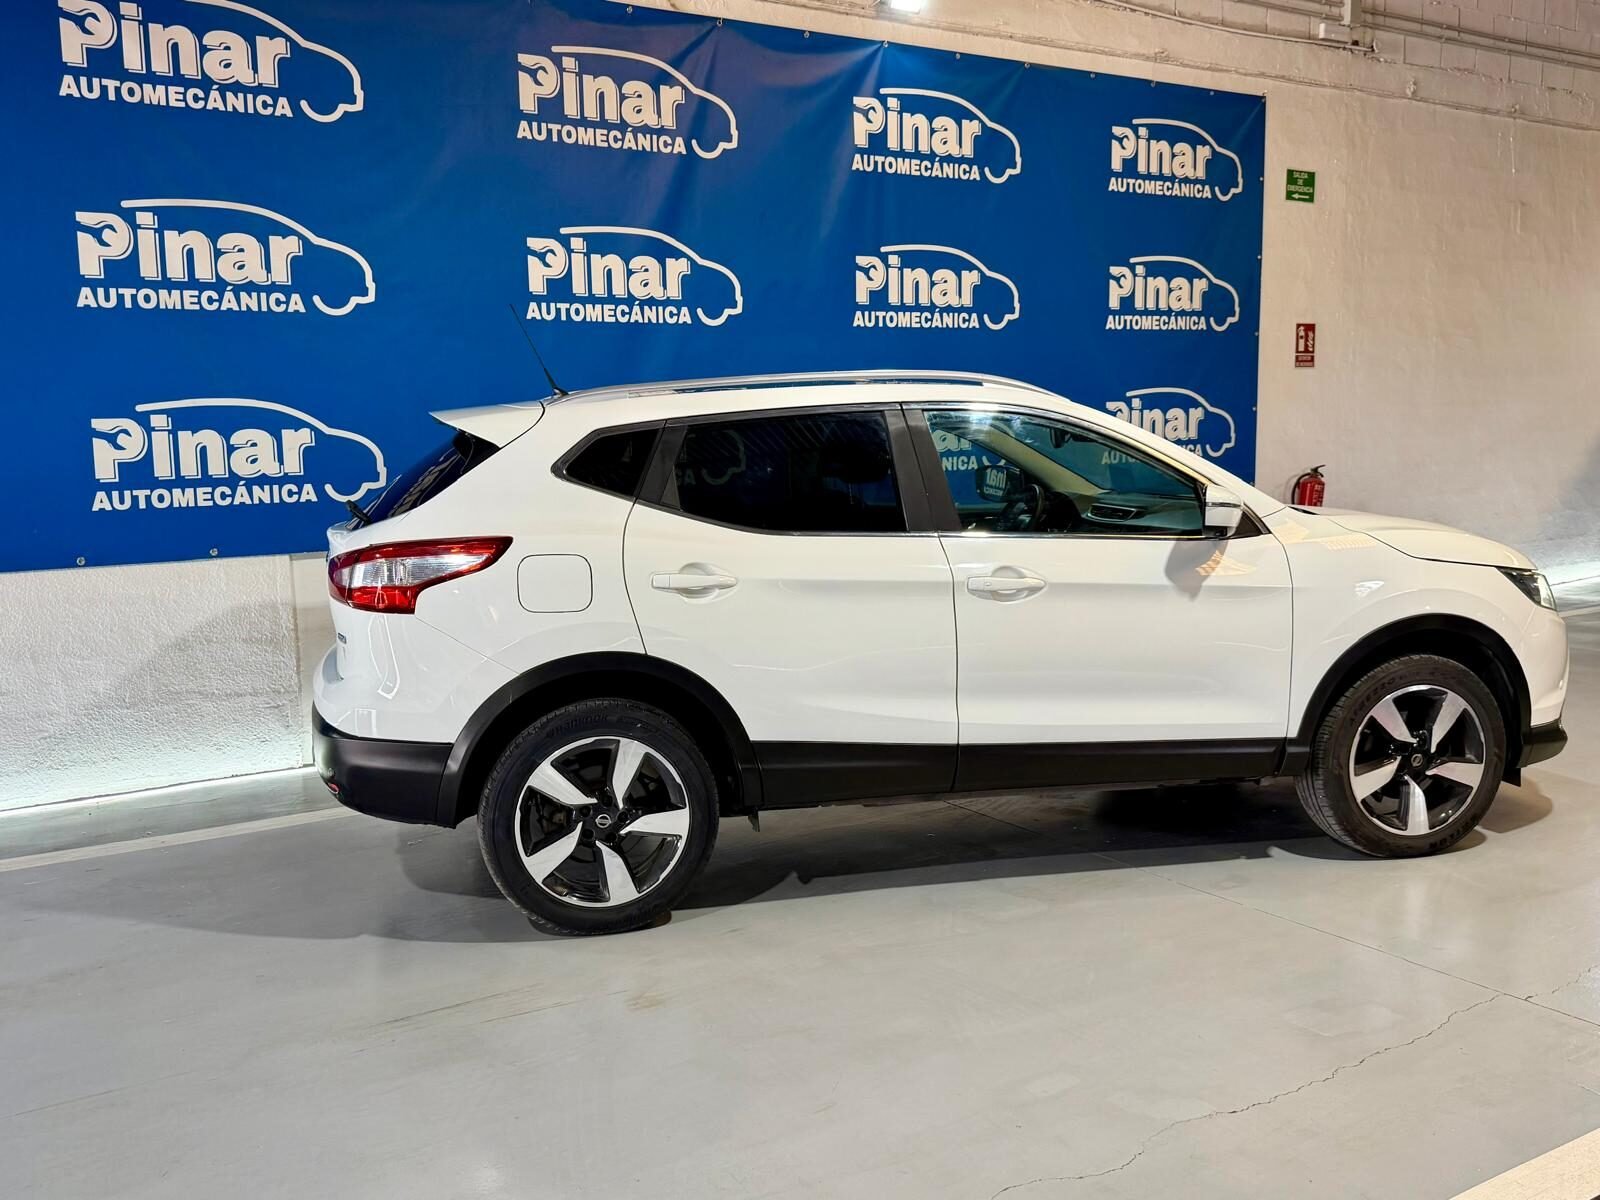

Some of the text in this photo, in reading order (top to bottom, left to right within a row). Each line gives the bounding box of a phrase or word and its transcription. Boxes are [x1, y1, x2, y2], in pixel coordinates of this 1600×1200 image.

[58, 0, 292, 89] Pinar
[58, 75, 294, 118] AUTOMECÁNICA
[518, 52, 686, 130] Pinar
[517, 121, 687, 155] AUTOMECÁNICA
[852, 96, 982, 158] Pinar
[852, 154, 981, 181] AUTOMECÁNICA
[1111, 125, 1213, 180] Pinar
[1108, 176, 1212, 199] AUTOMECÁNICA
[76, 212, 304, 286] Pinar
[526, 237, 691, 300] Pinar
[77, 286, 306, 313] AUTOMECÁNICA
[855, 254, 982, 307] Pinar
[1108, 264, 1211, 312] Pinar
[526, 301, 692, 325] AUTOMECÁNICA
[852, 311, 980, 329] AUTOMECÁNICA
[1105, 314, 1207, 332] AUTOMECÁNICA
[91, 414, 316, 483] Pinar
[91, 484, 318, 512] AUTOMECÁNICA
